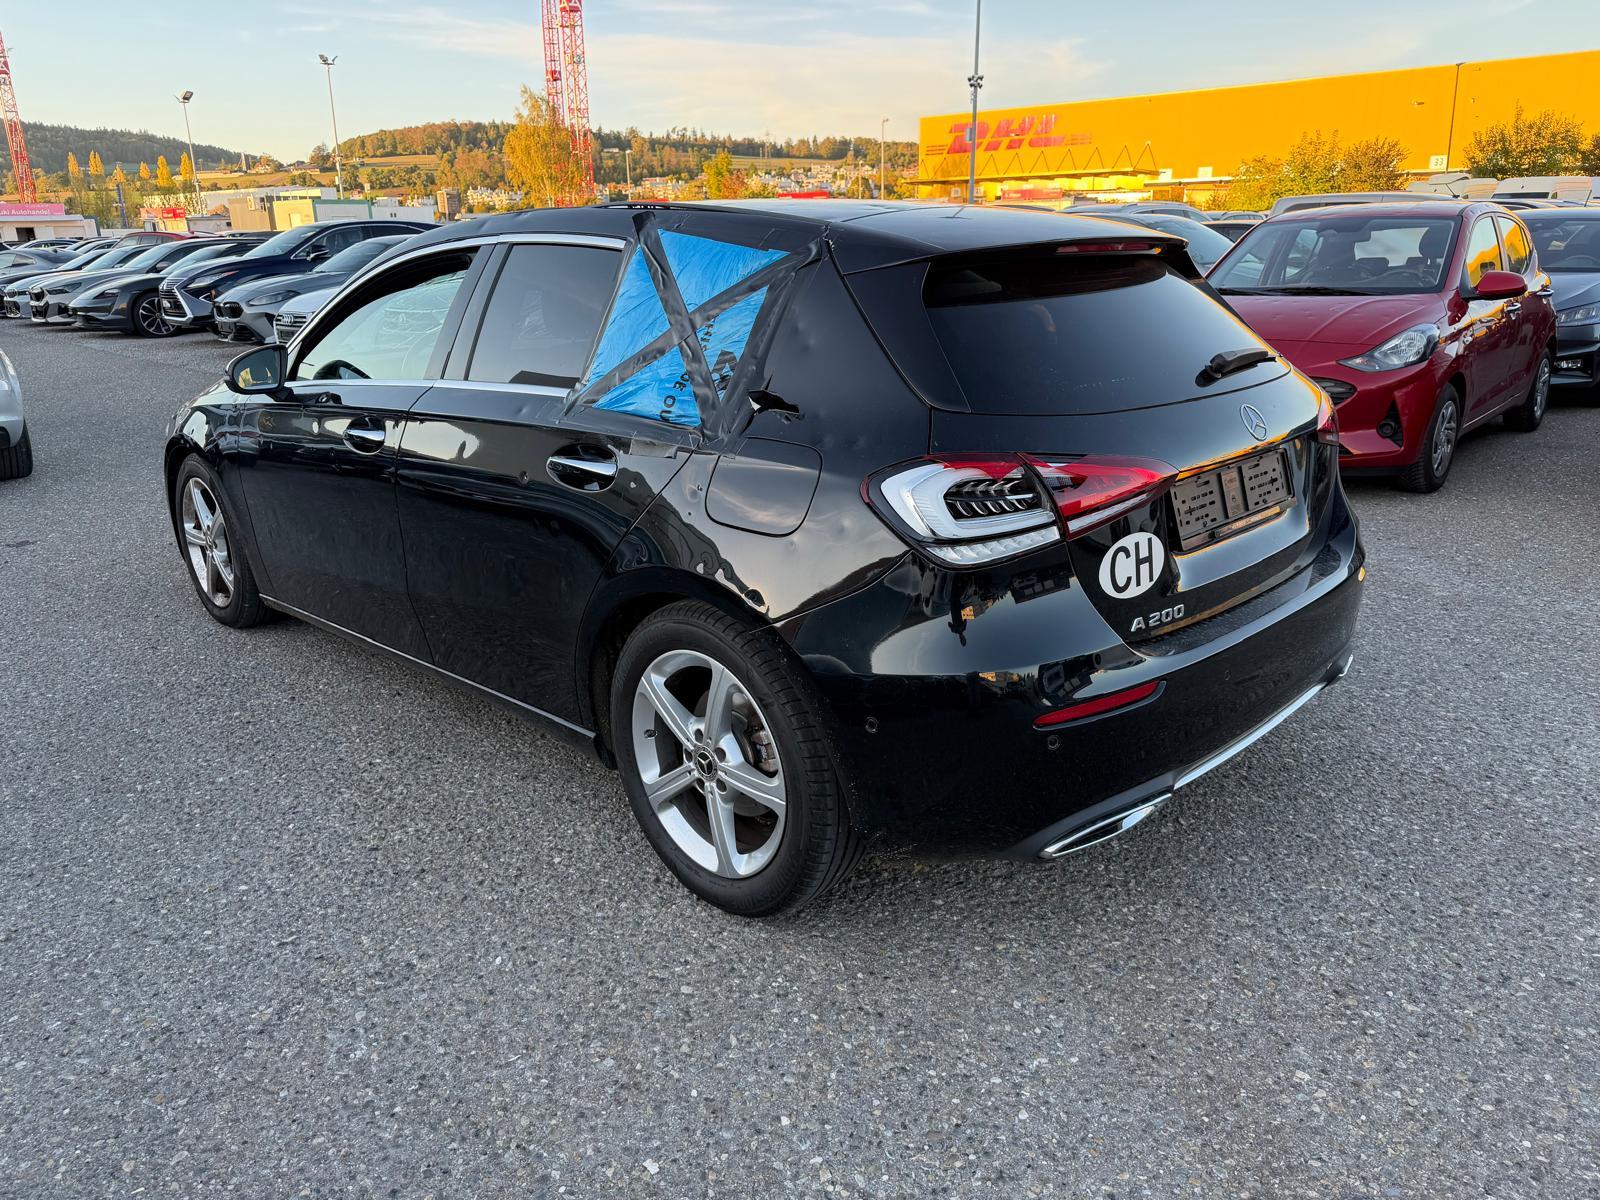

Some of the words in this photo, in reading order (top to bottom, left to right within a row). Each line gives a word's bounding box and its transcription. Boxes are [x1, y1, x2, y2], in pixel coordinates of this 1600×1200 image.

[947, 114, 1065, 154] DHL
[1109, 536, 1154, 594] CH
[1130, 616, 1146, 632] A
[1148, 604, 1185, 627] 200
